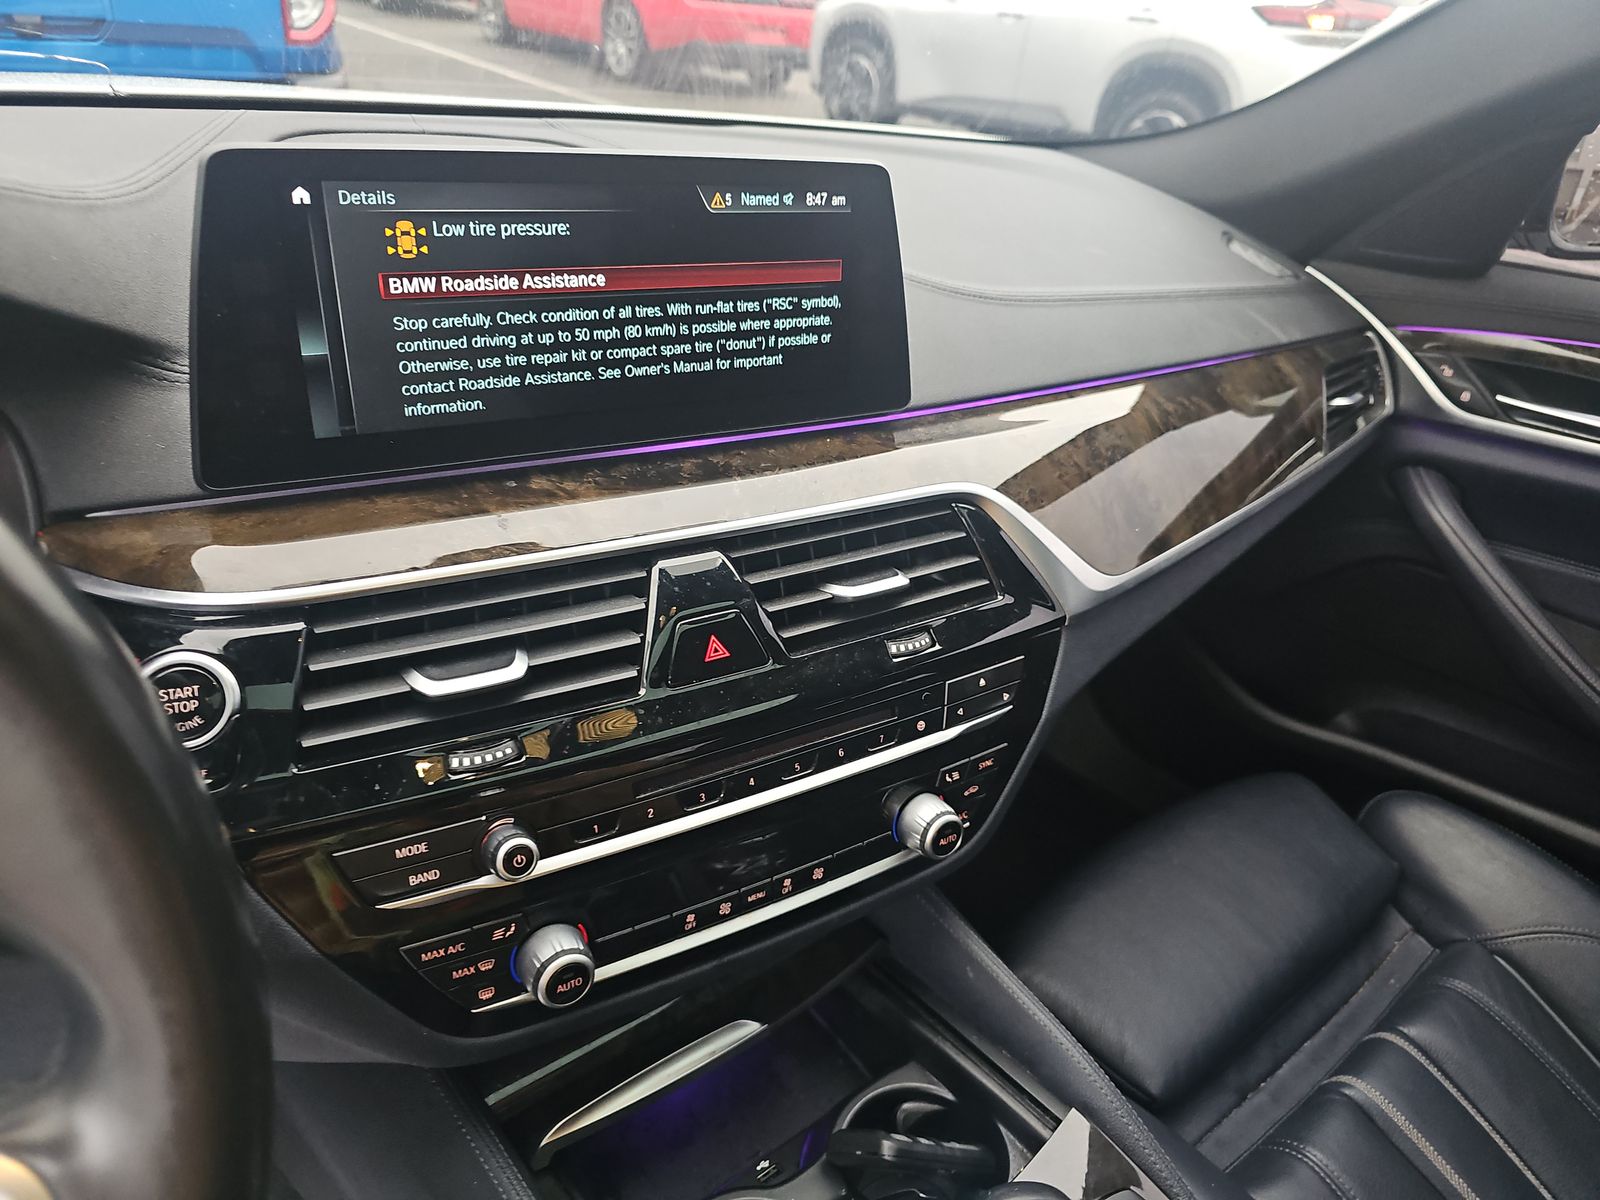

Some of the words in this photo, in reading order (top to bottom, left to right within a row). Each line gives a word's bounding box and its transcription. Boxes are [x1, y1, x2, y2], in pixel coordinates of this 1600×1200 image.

[338, 190, 395, 205] Details
[726, 193, 732, 206] 5
[741, 192, 779, 206] Named
[806, 192, 827, 206] 8:47
[831, 195, 846, 205] am
[432, 221, 465, 237] Low
[469, 221, 496, 236] tire
[501, 222, 570, 239] pressure:
[388, 277, 436, 294] BMW
[441, 275, 519, 292] Roadside
[522, 273, 606, 289] Assistance
[393, 316, 427, 332] Stop
[432, 313, 493, 329] carefully.
[497, 310, 538, 326] Check
[541, 307, 599, 323] condition
[603, 306, 615, 320] of
[619, 305, 632, 318] all
[635, 304, 664, 318] tires.
[667, 303, 692, 316] With
[695, 300, 734, 315] run-flat
[737, 300, 760, 312] tires
[763, 297, 798, 313] ("RSC"
[801, 295, 841, 310] symbol),
[396, 336, 467, 353] continued
[472, 334, 516, 349] driving
[520, 332, 534, 345] at
[538, 334, 554, 346] up
[558, 330, 571, 343] to
[575, 328, 590, 341] 50
[594, 327, 620, 343] mph
[624, 325, 641, 340] (80
[645, 324, 676, 338] km/h)
[680, 323, 689, 334] is
[692, 320, 736, 336] possible
[740, 318, 770, 330] where
[774, 315, 832, 330] appropriate.
[399, 358, 473, 374] Otherwise,
[477, 357, 501, 369] use
[505, 354, 527, 367] tire
[531, 351, 568, 366] repair
[572, 349, 587, 362] kit
[590, 348, 604, 359] or
[606, 344, 657, 360] compact
[660, 343, 691, 358] spare
[695, 341, 713, 352] tire
[716, 337, 766, 353] ("donut")
[768, 336, 775, 347] if
[778, 333, 819, 349] possible
[821, 333, 832, 343] or
[402, 380, 455, 396] contact
[459, 375, 521, 392] Roadside
[525, 371, 595, 386] Assistance.
[598, 364, 622, 380] See
[625, 363, 670, 378] Owner's
[673, 359, 713, 374] Manual
[716, 357, 731, 369] for
[734, 353, 783, 370] important
[404, 399, 486, 417] information.
[159, 685, 200, 702] START
[164, 700, 199, 714] STOP
[593, 825, 599, 833] 1
[648, 809, 654, 818] 2
[700, 793, 705, 802] 3
[749, 777, 755, 786] 4
[794, 763, 800, 772] 5
[838, 748, 844, 757] 6
[939, 834, 957, 847] AUTO
[395, 842, 429, 859] MODE
[408, 869, 440, 886] BAND
[748, 890, 766, 902] MENU
[782, 885, 792, 894] OFF
[685, 921, 696, 930] OFF
[421, 950, 445, 962] MAX
[447, 943, 466, 955] A/C
[452, 966, 476, 979] MAX
[556, 978, 583, 993] AUTO
